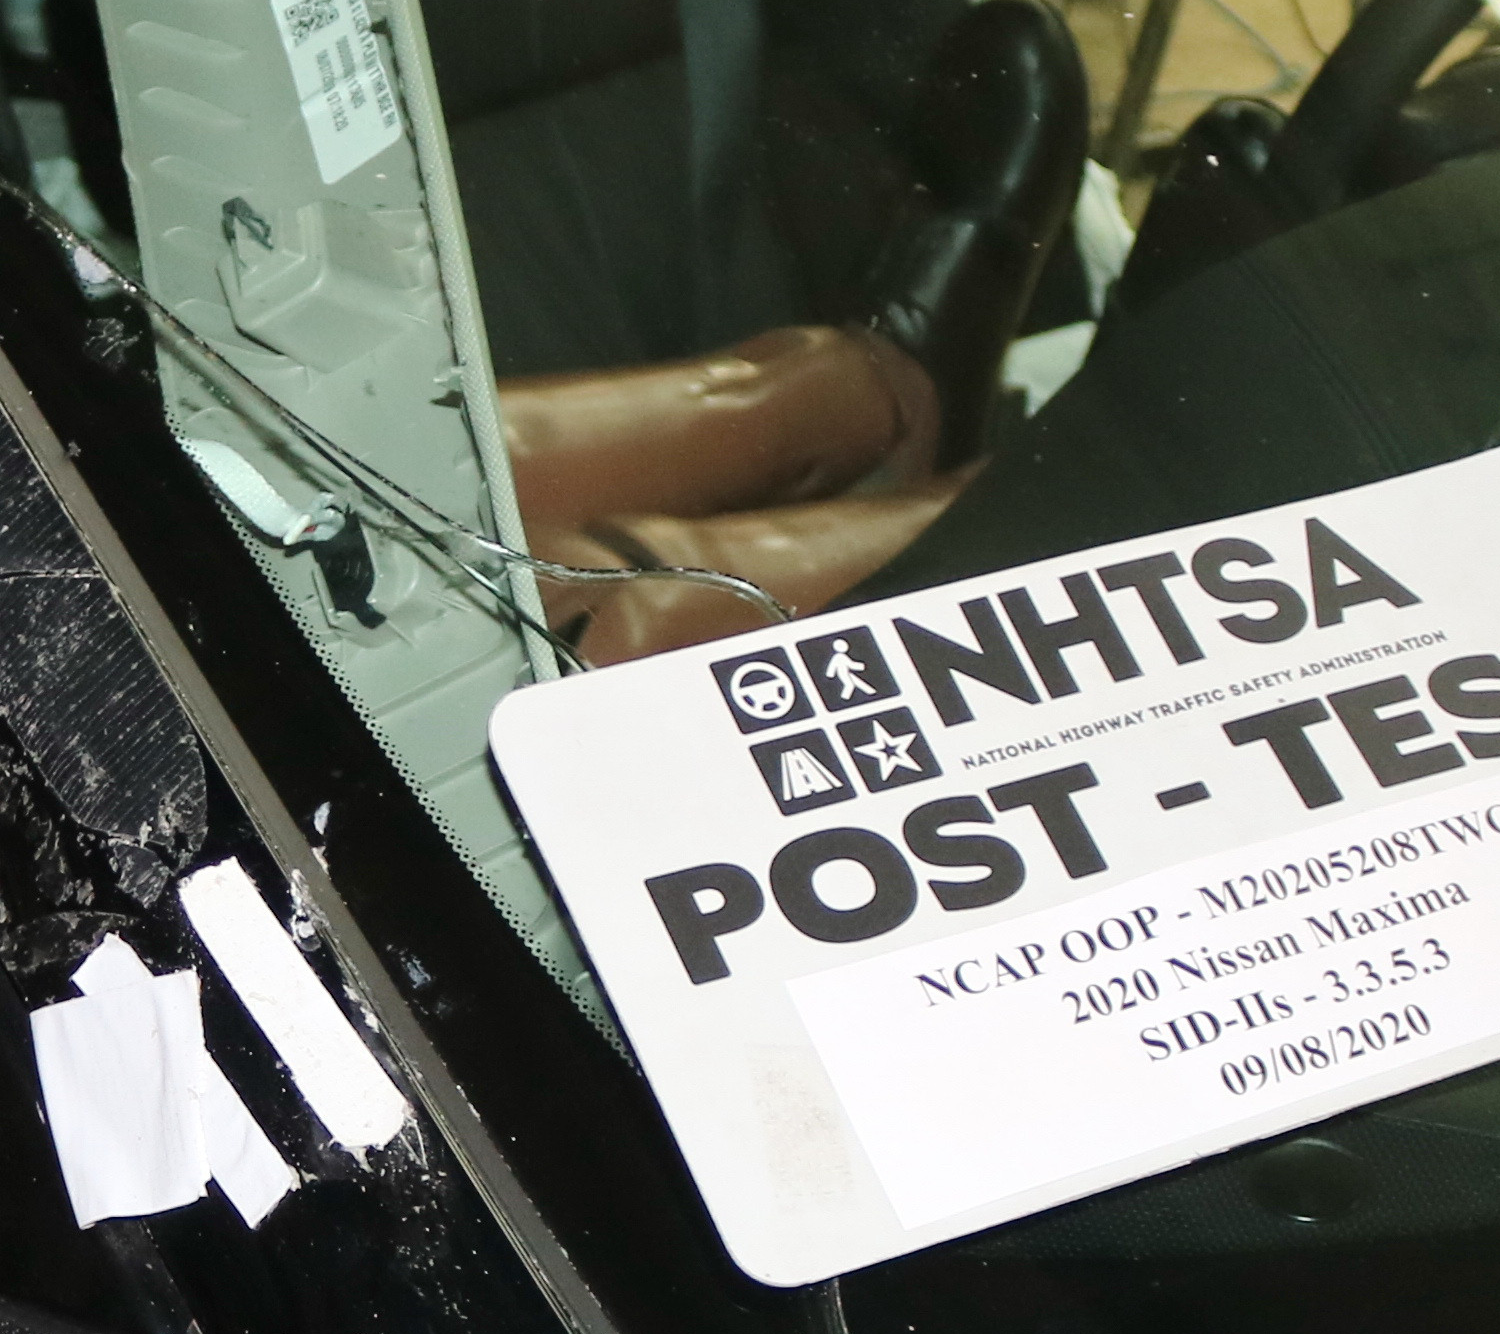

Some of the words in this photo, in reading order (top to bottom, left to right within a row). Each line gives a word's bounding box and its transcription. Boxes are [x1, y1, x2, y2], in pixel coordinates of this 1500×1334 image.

[891, 517, 1423, 728] NHTSA
[961, 734, 1058, 770] NATIONAL
[1058, 709, 1147, 744] HIGHWAY
[1148, 687, 1227, 719] TRAFFIC
[1229, 668, 1295, 698] SAFETY
[1298, 630, 1449, 679] ADMINISTRATION
[644, 762, 1108, 986] POST
[1155, 780, 1212, 811] -
[914, 942, 1047, 1008] NCAP
[1059, 904, 1160, 964] OOP
[1061, 967, 1161, 1025] 2020
[1165, 931, 1304, 994] Nissan
[1304, 881, 1472, 949] Maxima
[1138, 989, 1295, 1063] SID-IIs
[1322, 938, 1453, 1005] 3.3.5.3
[1219, 1003, 1433, 1097] 09/08/2020
